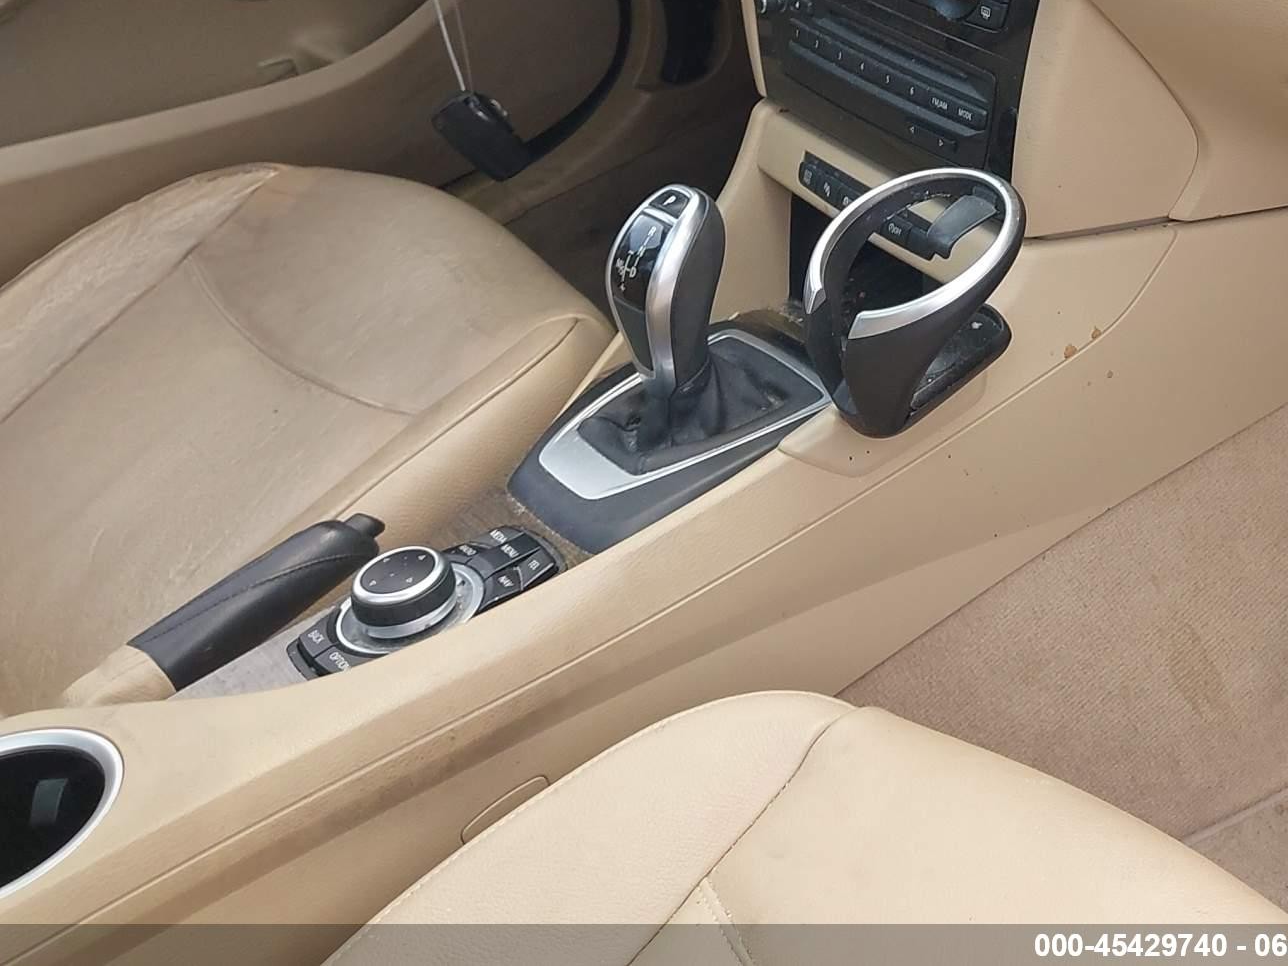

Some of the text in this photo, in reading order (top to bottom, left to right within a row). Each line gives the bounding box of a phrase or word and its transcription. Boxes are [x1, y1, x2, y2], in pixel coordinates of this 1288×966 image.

[663, 195, 676, 206] P
[647, 225, 657, 236] R
[629, 267, 637, 277] D
[501, 544, 520, 558] MENU
[497, 575, 515, 587] NAV
[307, 629, 325, 645] BACK
